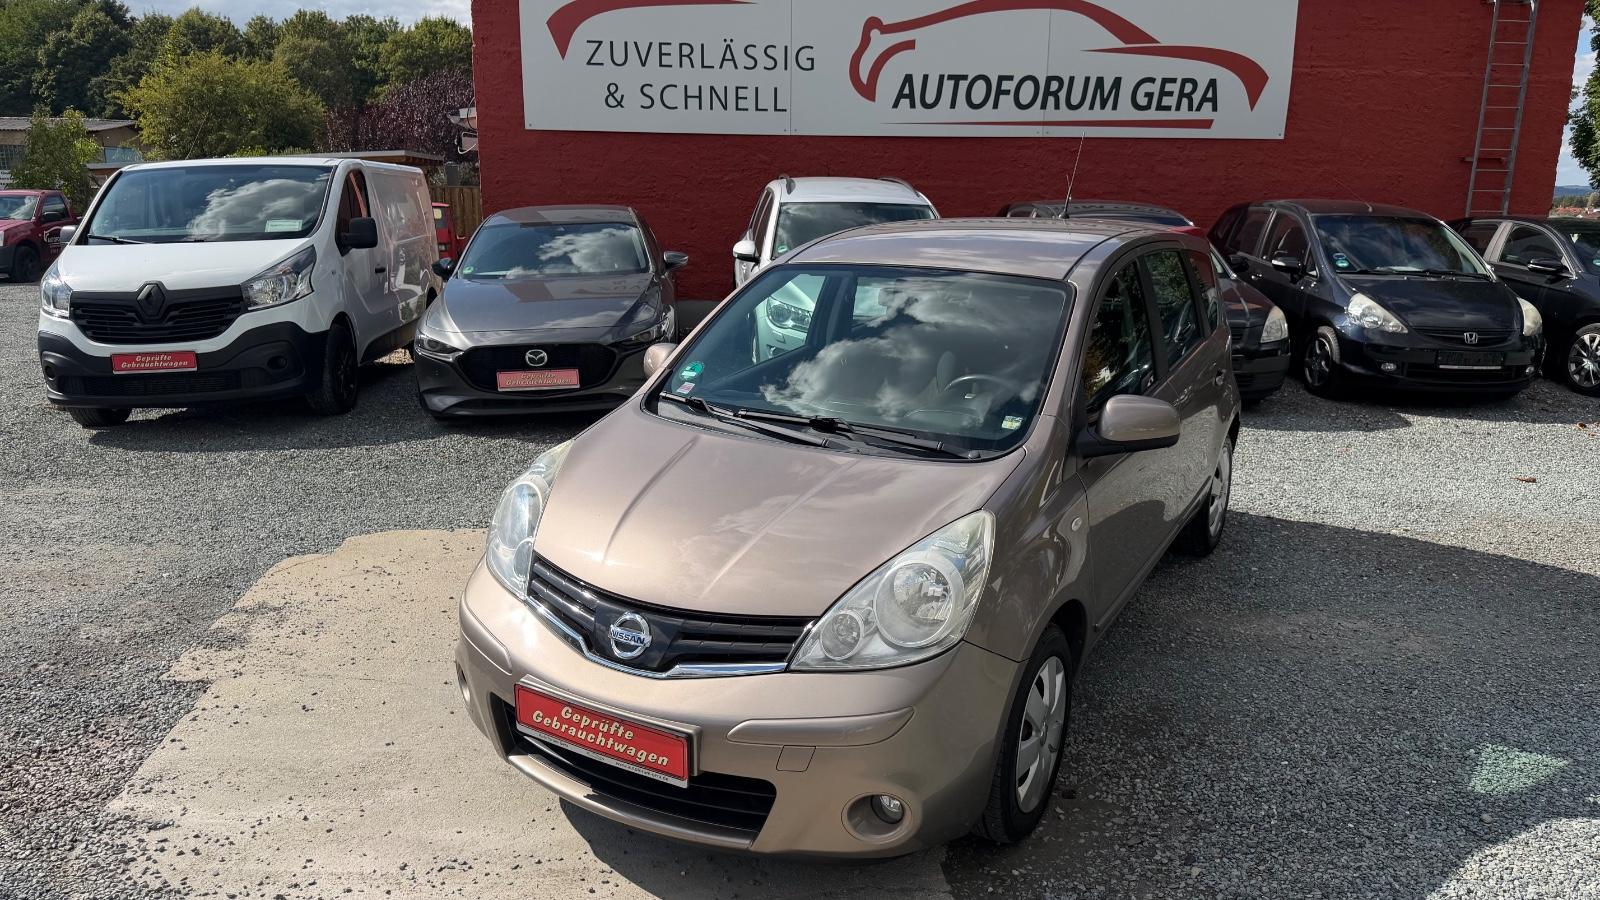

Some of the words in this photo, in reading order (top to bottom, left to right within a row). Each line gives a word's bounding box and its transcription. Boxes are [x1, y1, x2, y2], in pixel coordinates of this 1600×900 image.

[586, 38, 815, 72] ZUVERLÄSSIG
[604, 82, 625, 109] &
[640, 83, 788, 112] SCHNELL
[892, 73, 1122, 112] AUTOFORUM
[1130, 77, 1218, 113] GERA
[121, 360, 188, 369] Gebrauchtwagen
[135, 354, 172, 363] Geprüfte
[610, 629, 646, 645] NISSAN
[531, 710, 669, 767] Gebrauchtwagen
[560, 705, 635, 741] Geprüfte
